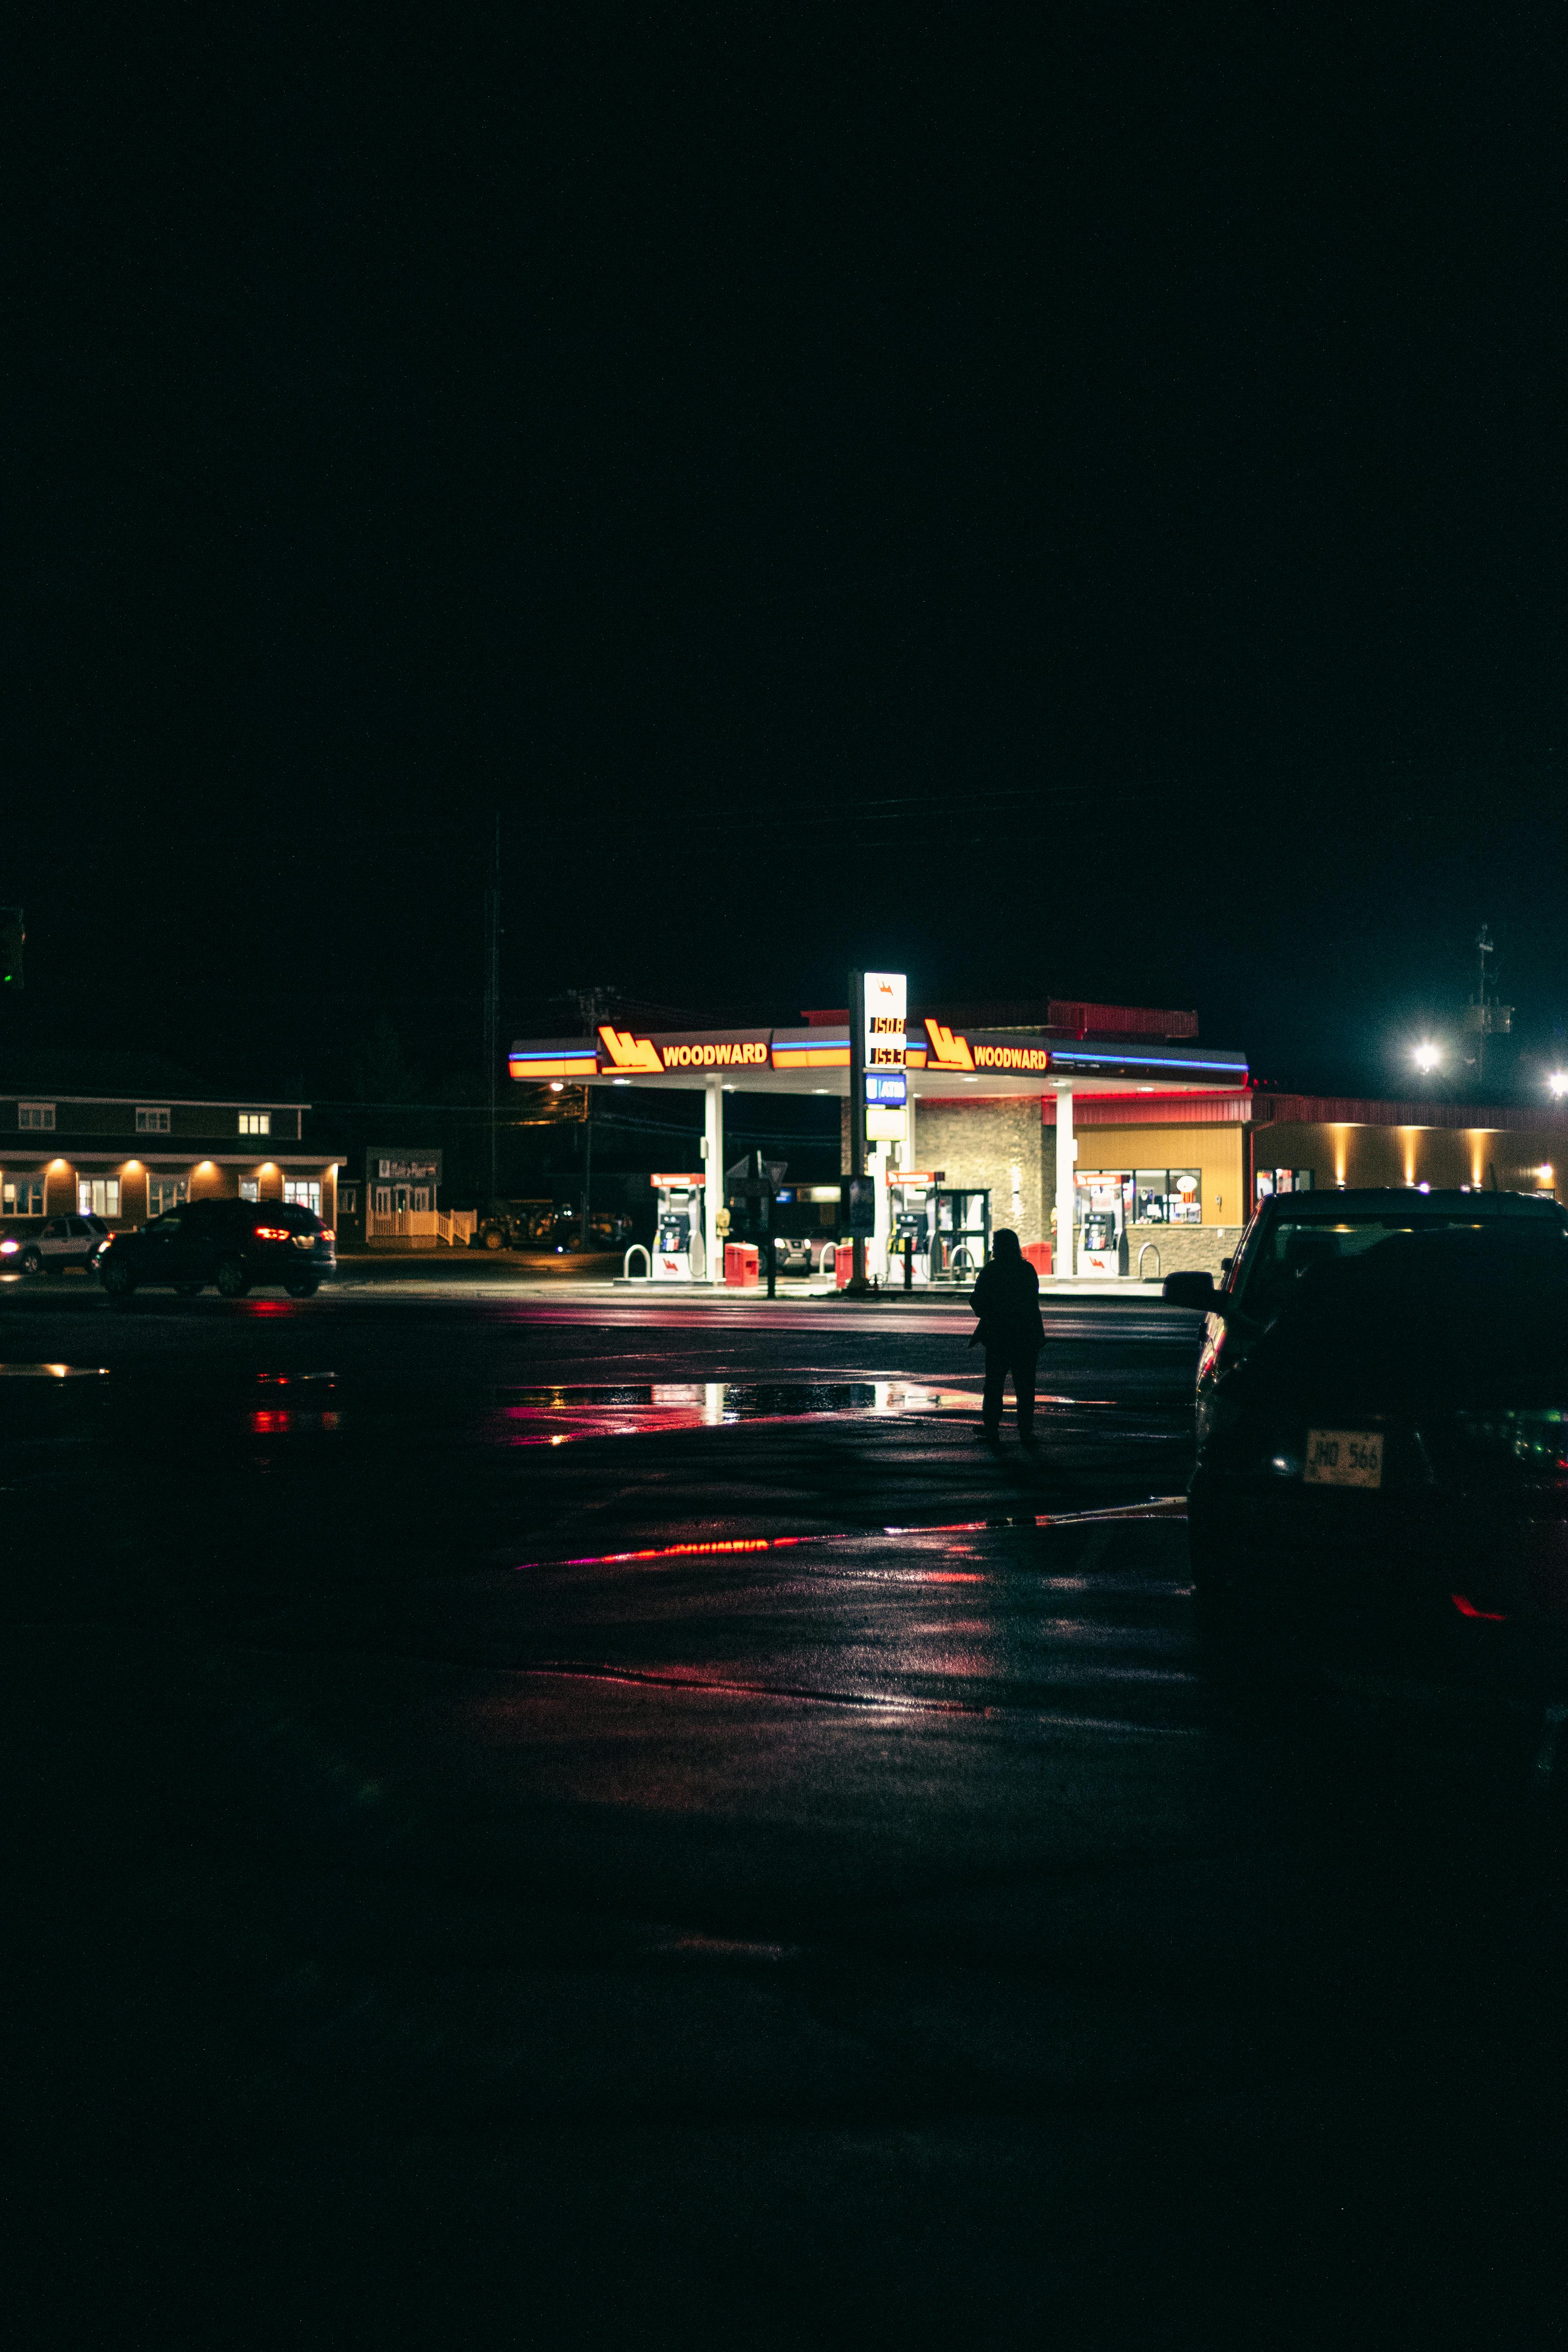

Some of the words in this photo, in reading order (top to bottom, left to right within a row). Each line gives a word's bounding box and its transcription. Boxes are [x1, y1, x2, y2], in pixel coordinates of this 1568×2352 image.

[875, 1018, 904, 1034] 150.8
[662, 1043, 767, 1066] WOODWARD
[875, 1048, 904, 1064] 153.3
[974, 1046, 1047, 1070] WOODWARD
[1349, 1443, 1377, 1469] 566
